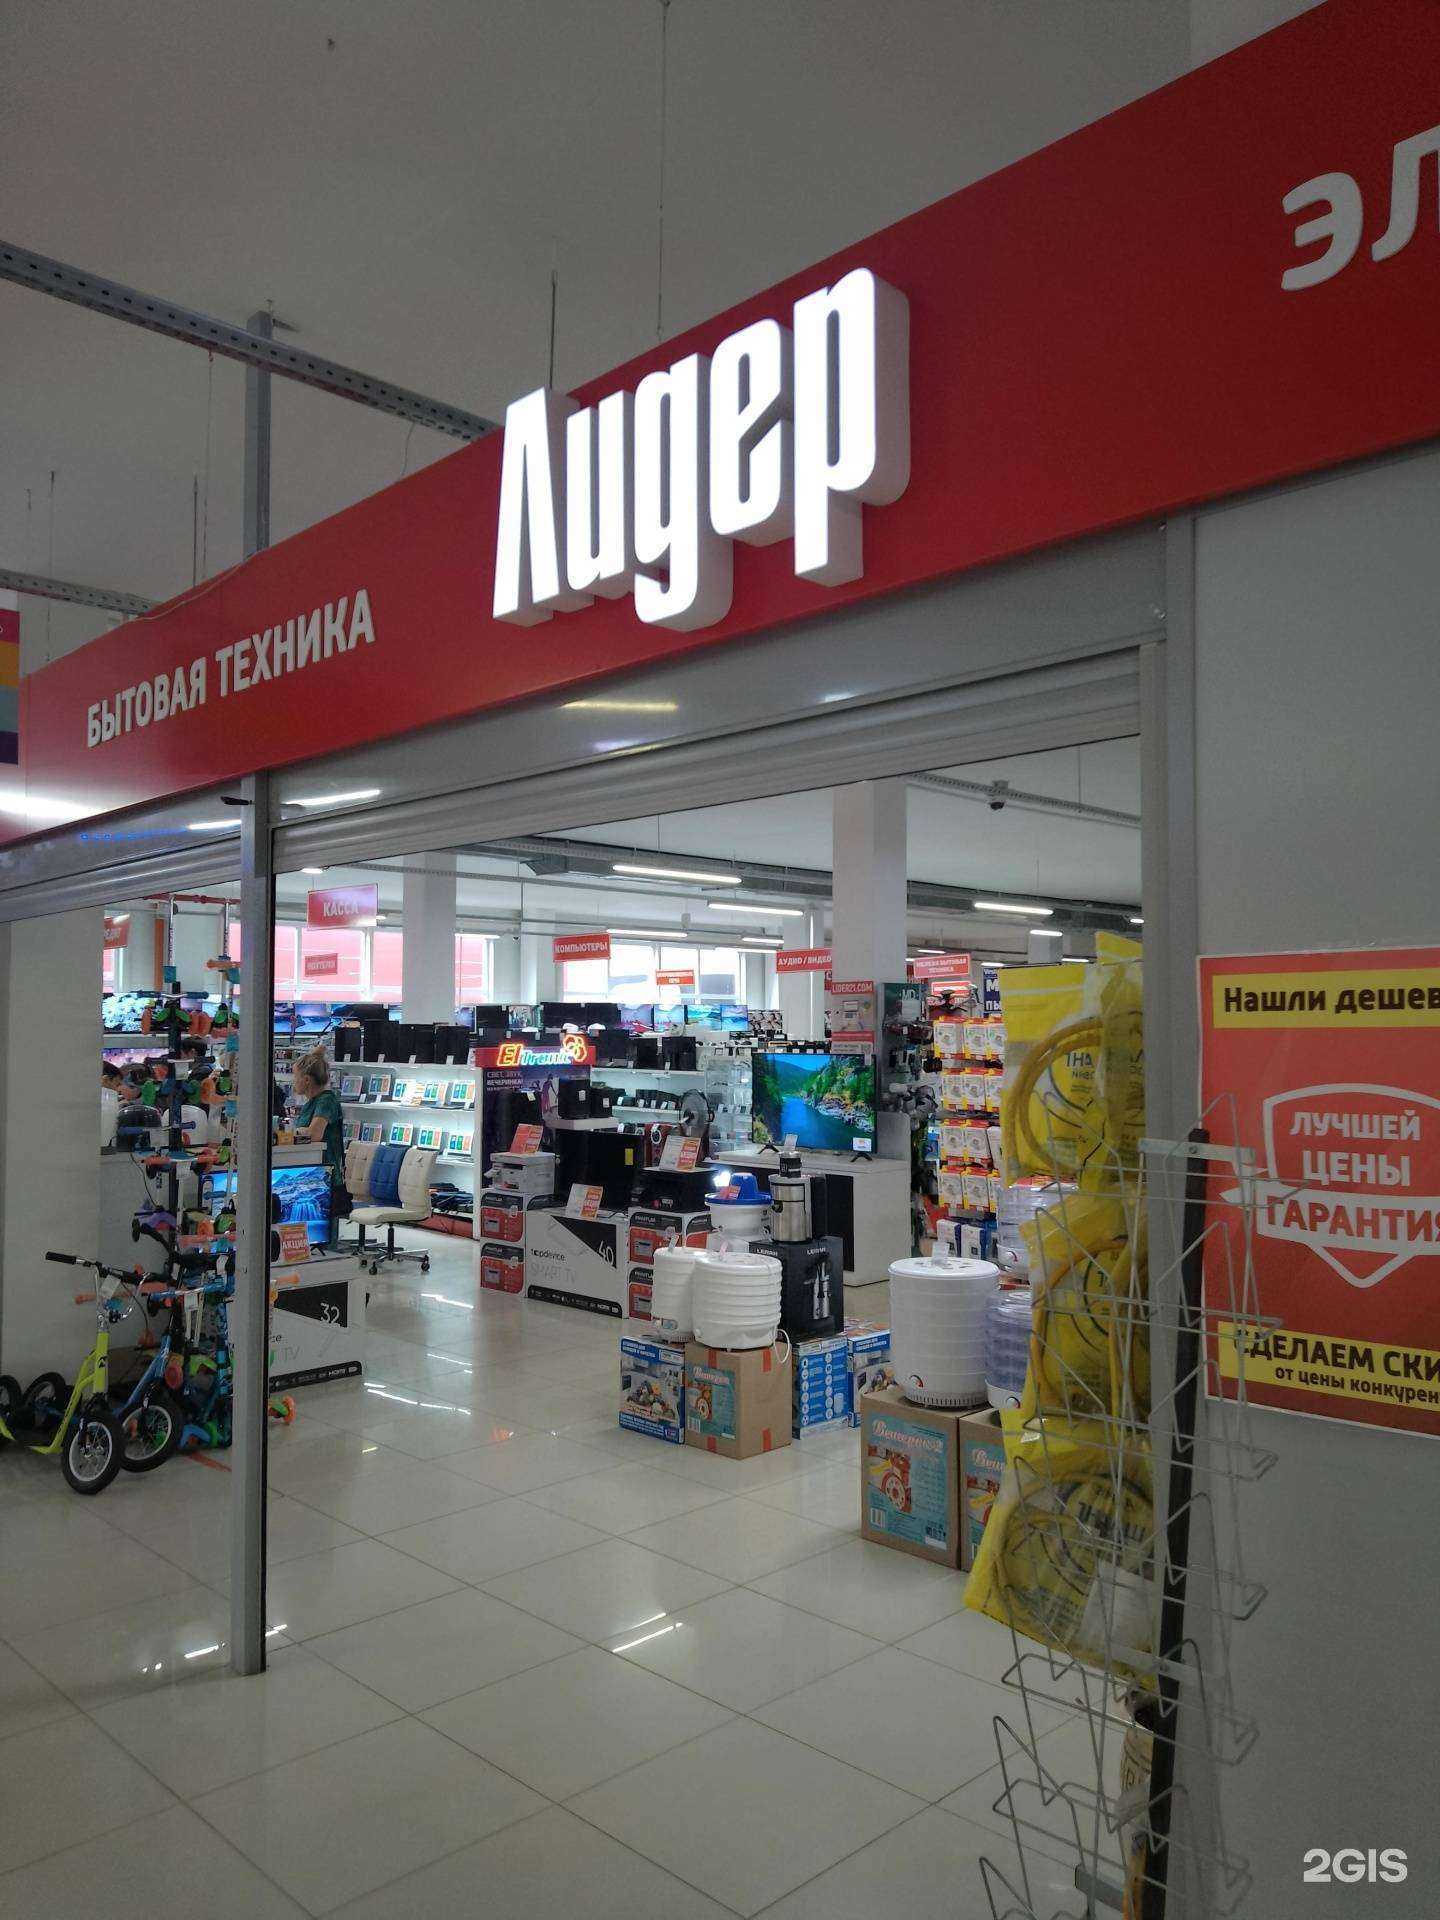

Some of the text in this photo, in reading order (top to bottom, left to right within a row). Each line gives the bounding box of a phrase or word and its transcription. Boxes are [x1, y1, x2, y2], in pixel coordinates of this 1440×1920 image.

[87, 588, 376, 748] БЫТОВАЯ ТЕХНИКА
[554, 942, 609, 954] КОМПЬЮТЕРЫ
[778, 956, 803, 966] АУДИО
[1224, 986, 1326, 1013] Нашли
[1290, 1110, 1421, 1141] ЛУЧШЕЙ
[1303, 1150, 1410, 1187] ЦЕНЫ
[1266, 1196, 1440, 1243] ГАРАНТИ
[320, 1302, 341, 1325] 32
[1275, 1366, 1294, 1380] от
[1299, 1370, 1345, 1389] цены
[1384, 1350, 1440, 1382] СКИ
